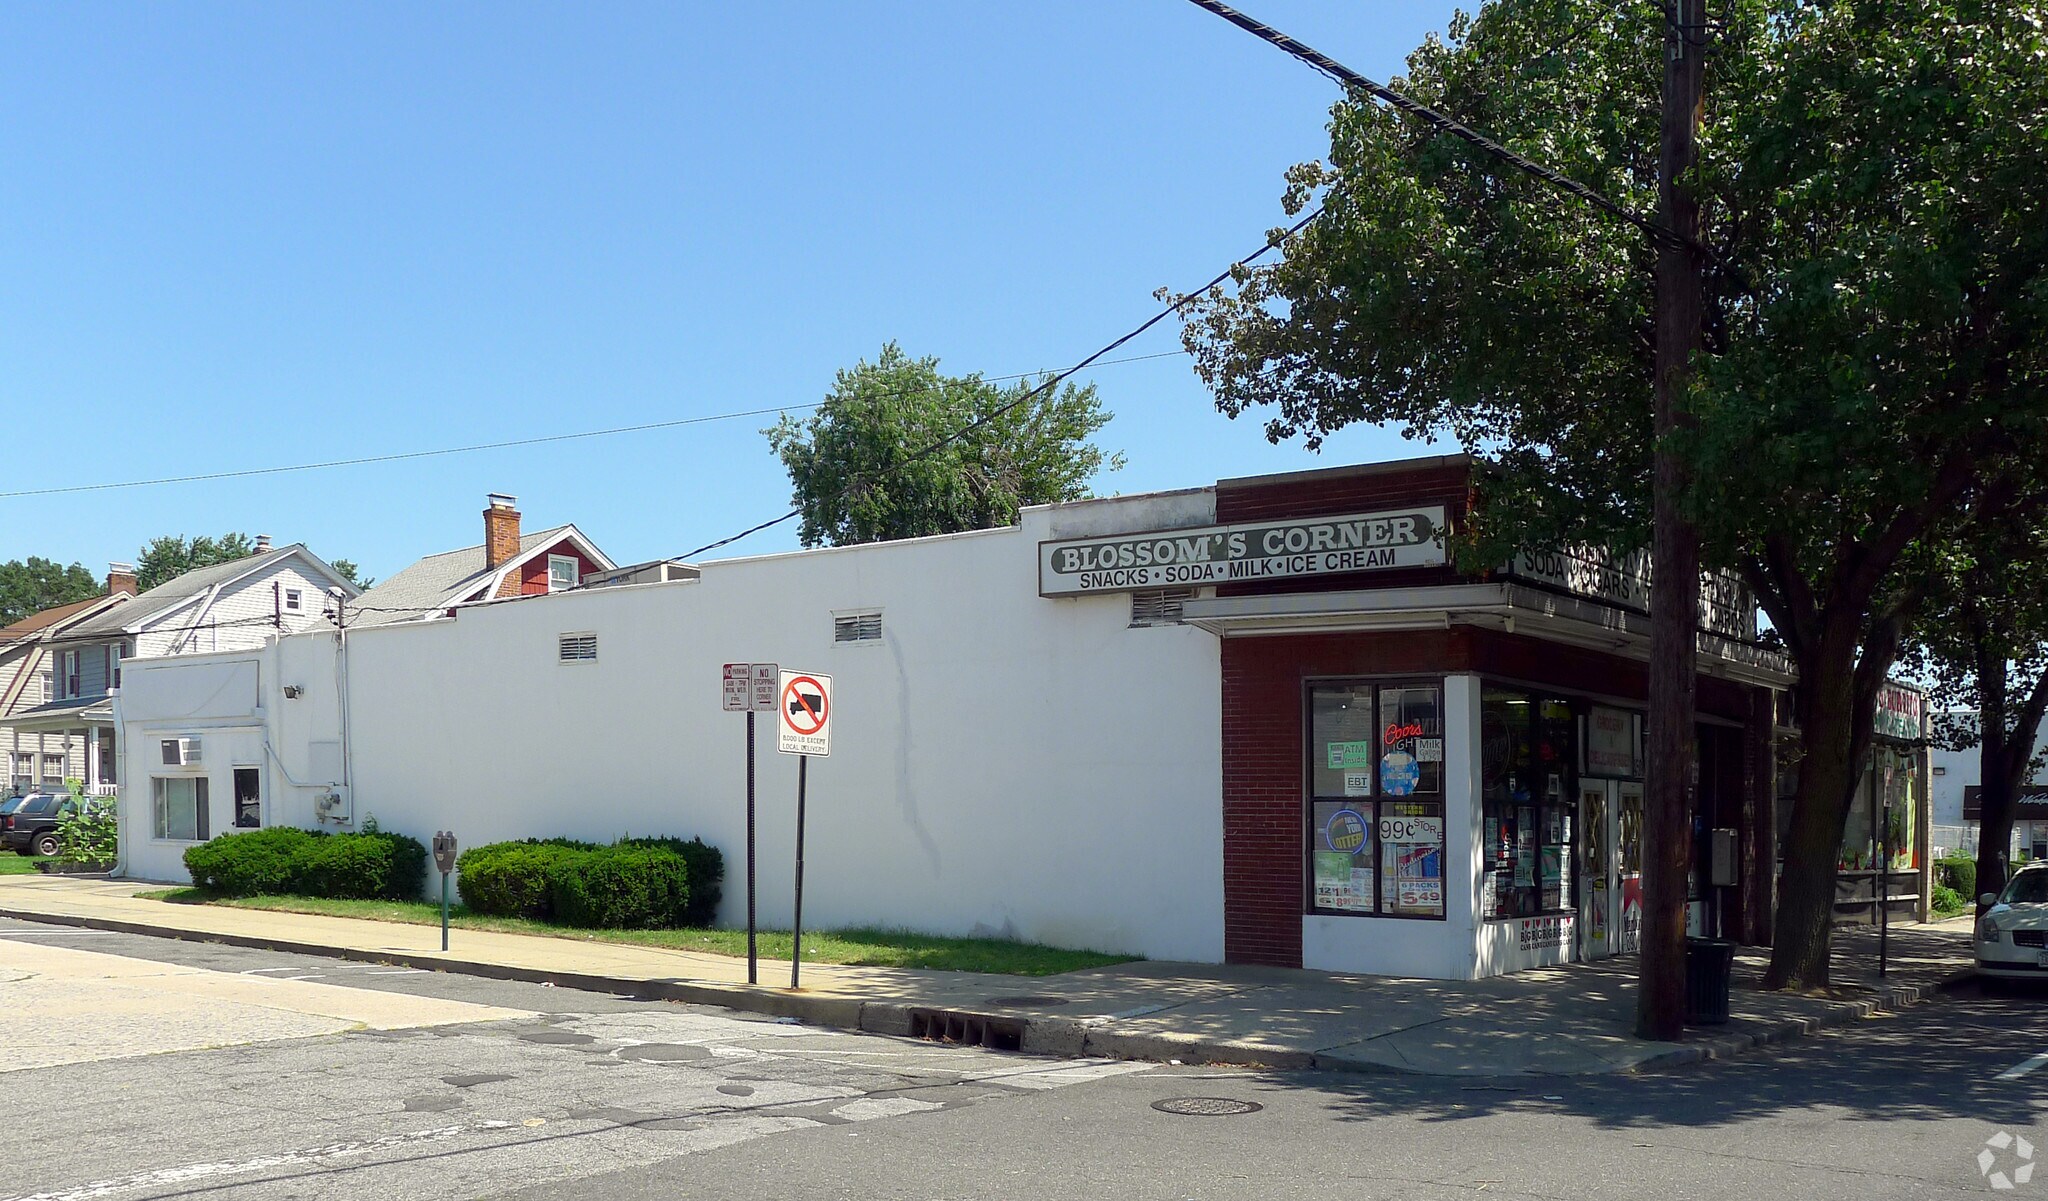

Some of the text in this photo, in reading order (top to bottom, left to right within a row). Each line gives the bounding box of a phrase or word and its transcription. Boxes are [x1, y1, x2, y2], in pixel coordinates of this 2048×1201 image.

[1062, 517, 1418, 572] BLOSSOM'S CORNER
[1080, 549, 1396, 589] SNACKS SODA MILK ICE CREAM
[1524, 549, 1565, 581] SODA
[1581, 565, 1630, 600] CIGARS
[760, 669, 768, 677] NO
[1385, 724, 1423, 745] Coors
[1420, 739, 1440, 749] Milk
[1345, 744, 1364, 754] ATM
[1348, 777, 1367, 786] EBT
[1414, 818, 1443, 840] STORE
